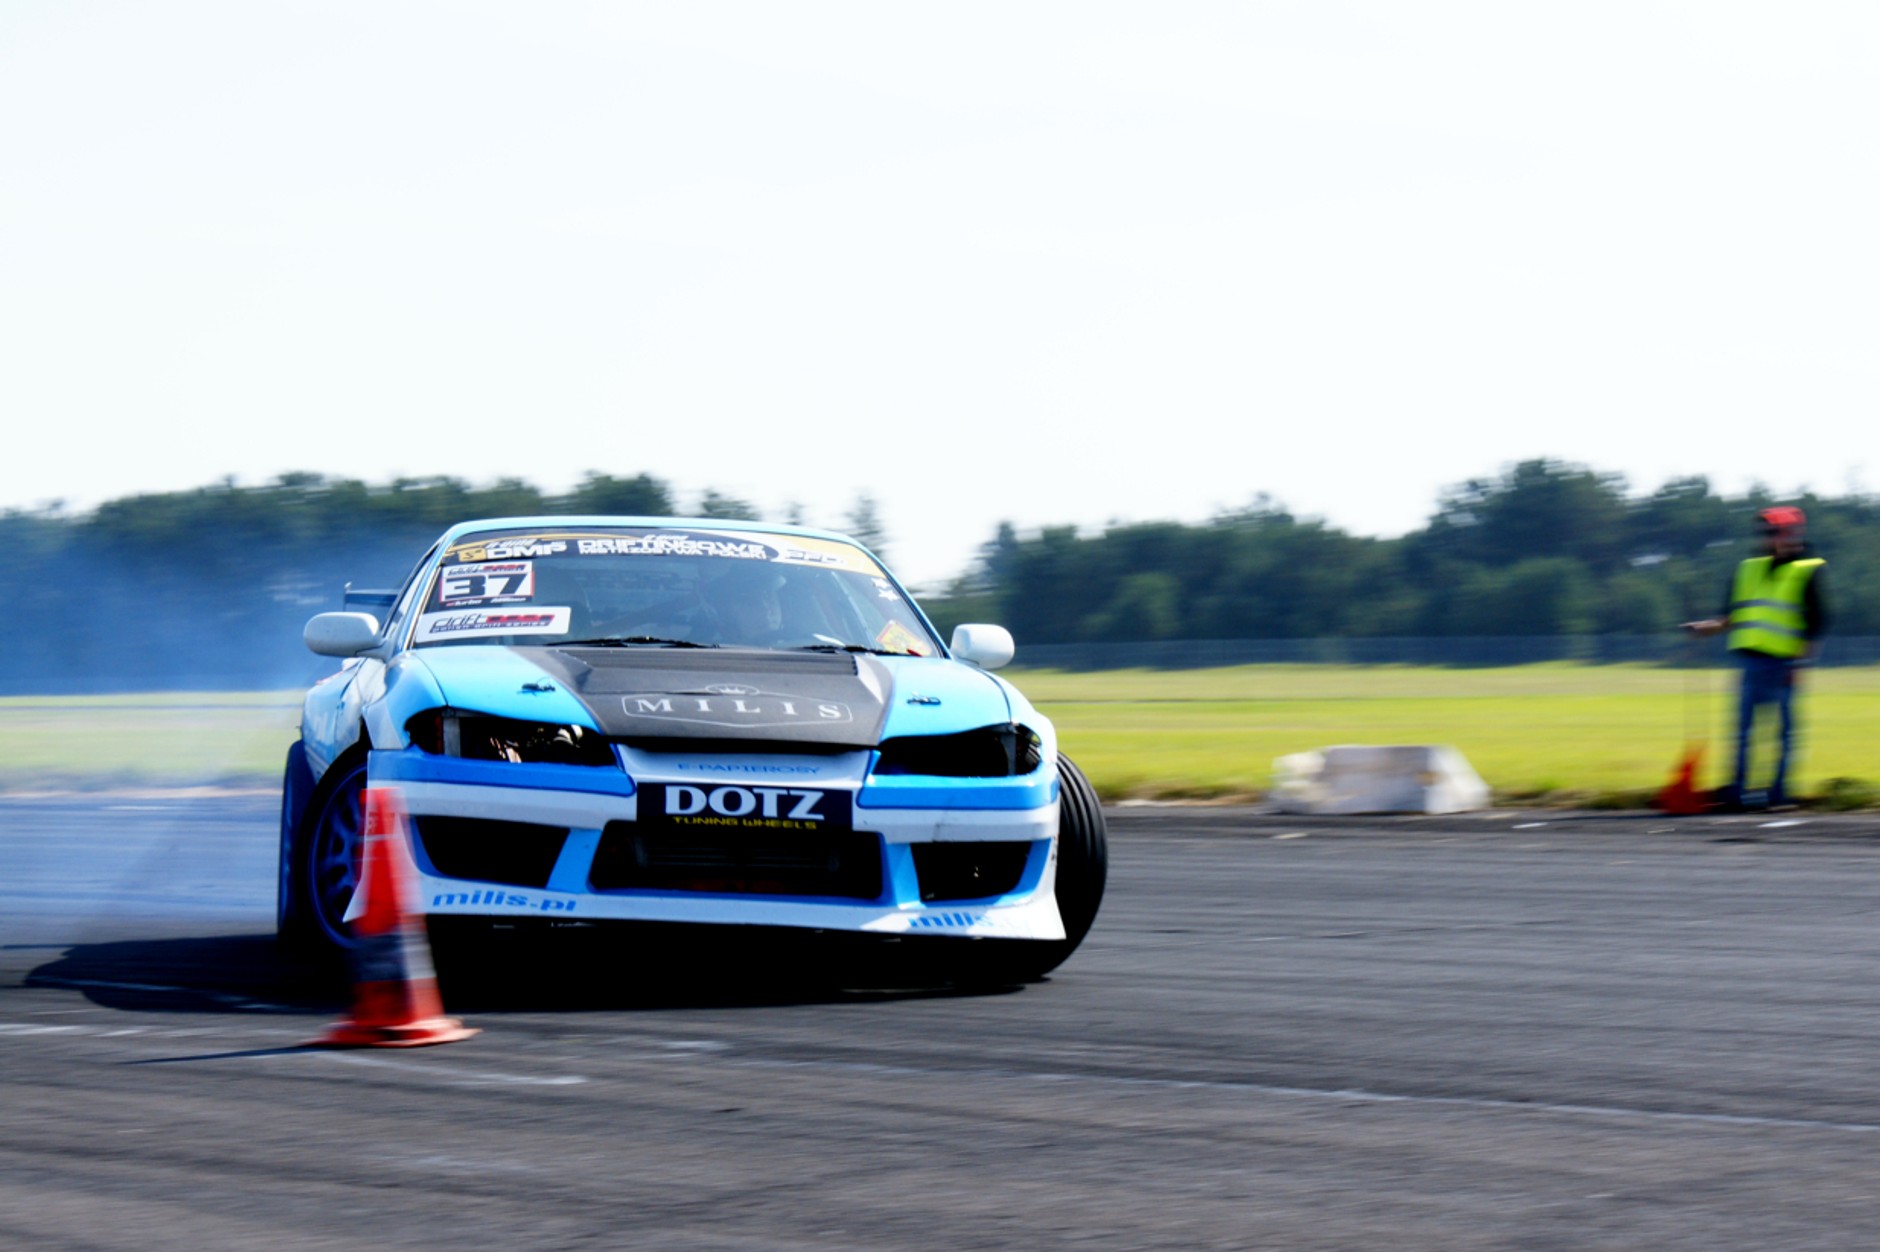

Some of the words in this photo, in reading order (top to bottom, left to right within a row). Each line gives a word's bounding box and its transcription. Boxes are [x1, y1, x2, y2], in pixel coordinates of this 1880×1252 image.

[486, 542, 568, 559] DMP
[577, 539, 766, 552] DRIFTINGOWE
[708, 549, 767, 560] POLSKI
[444, 573, 528, 600] 37
[636, 699, 842, 719] MILIS
[665, 785, 825, 820] DOTZ
[673, 816, 739, 827] TUNING
[742, 818, 818, 830] WHEELS
[432, 890, 577, 911] milis.pl
